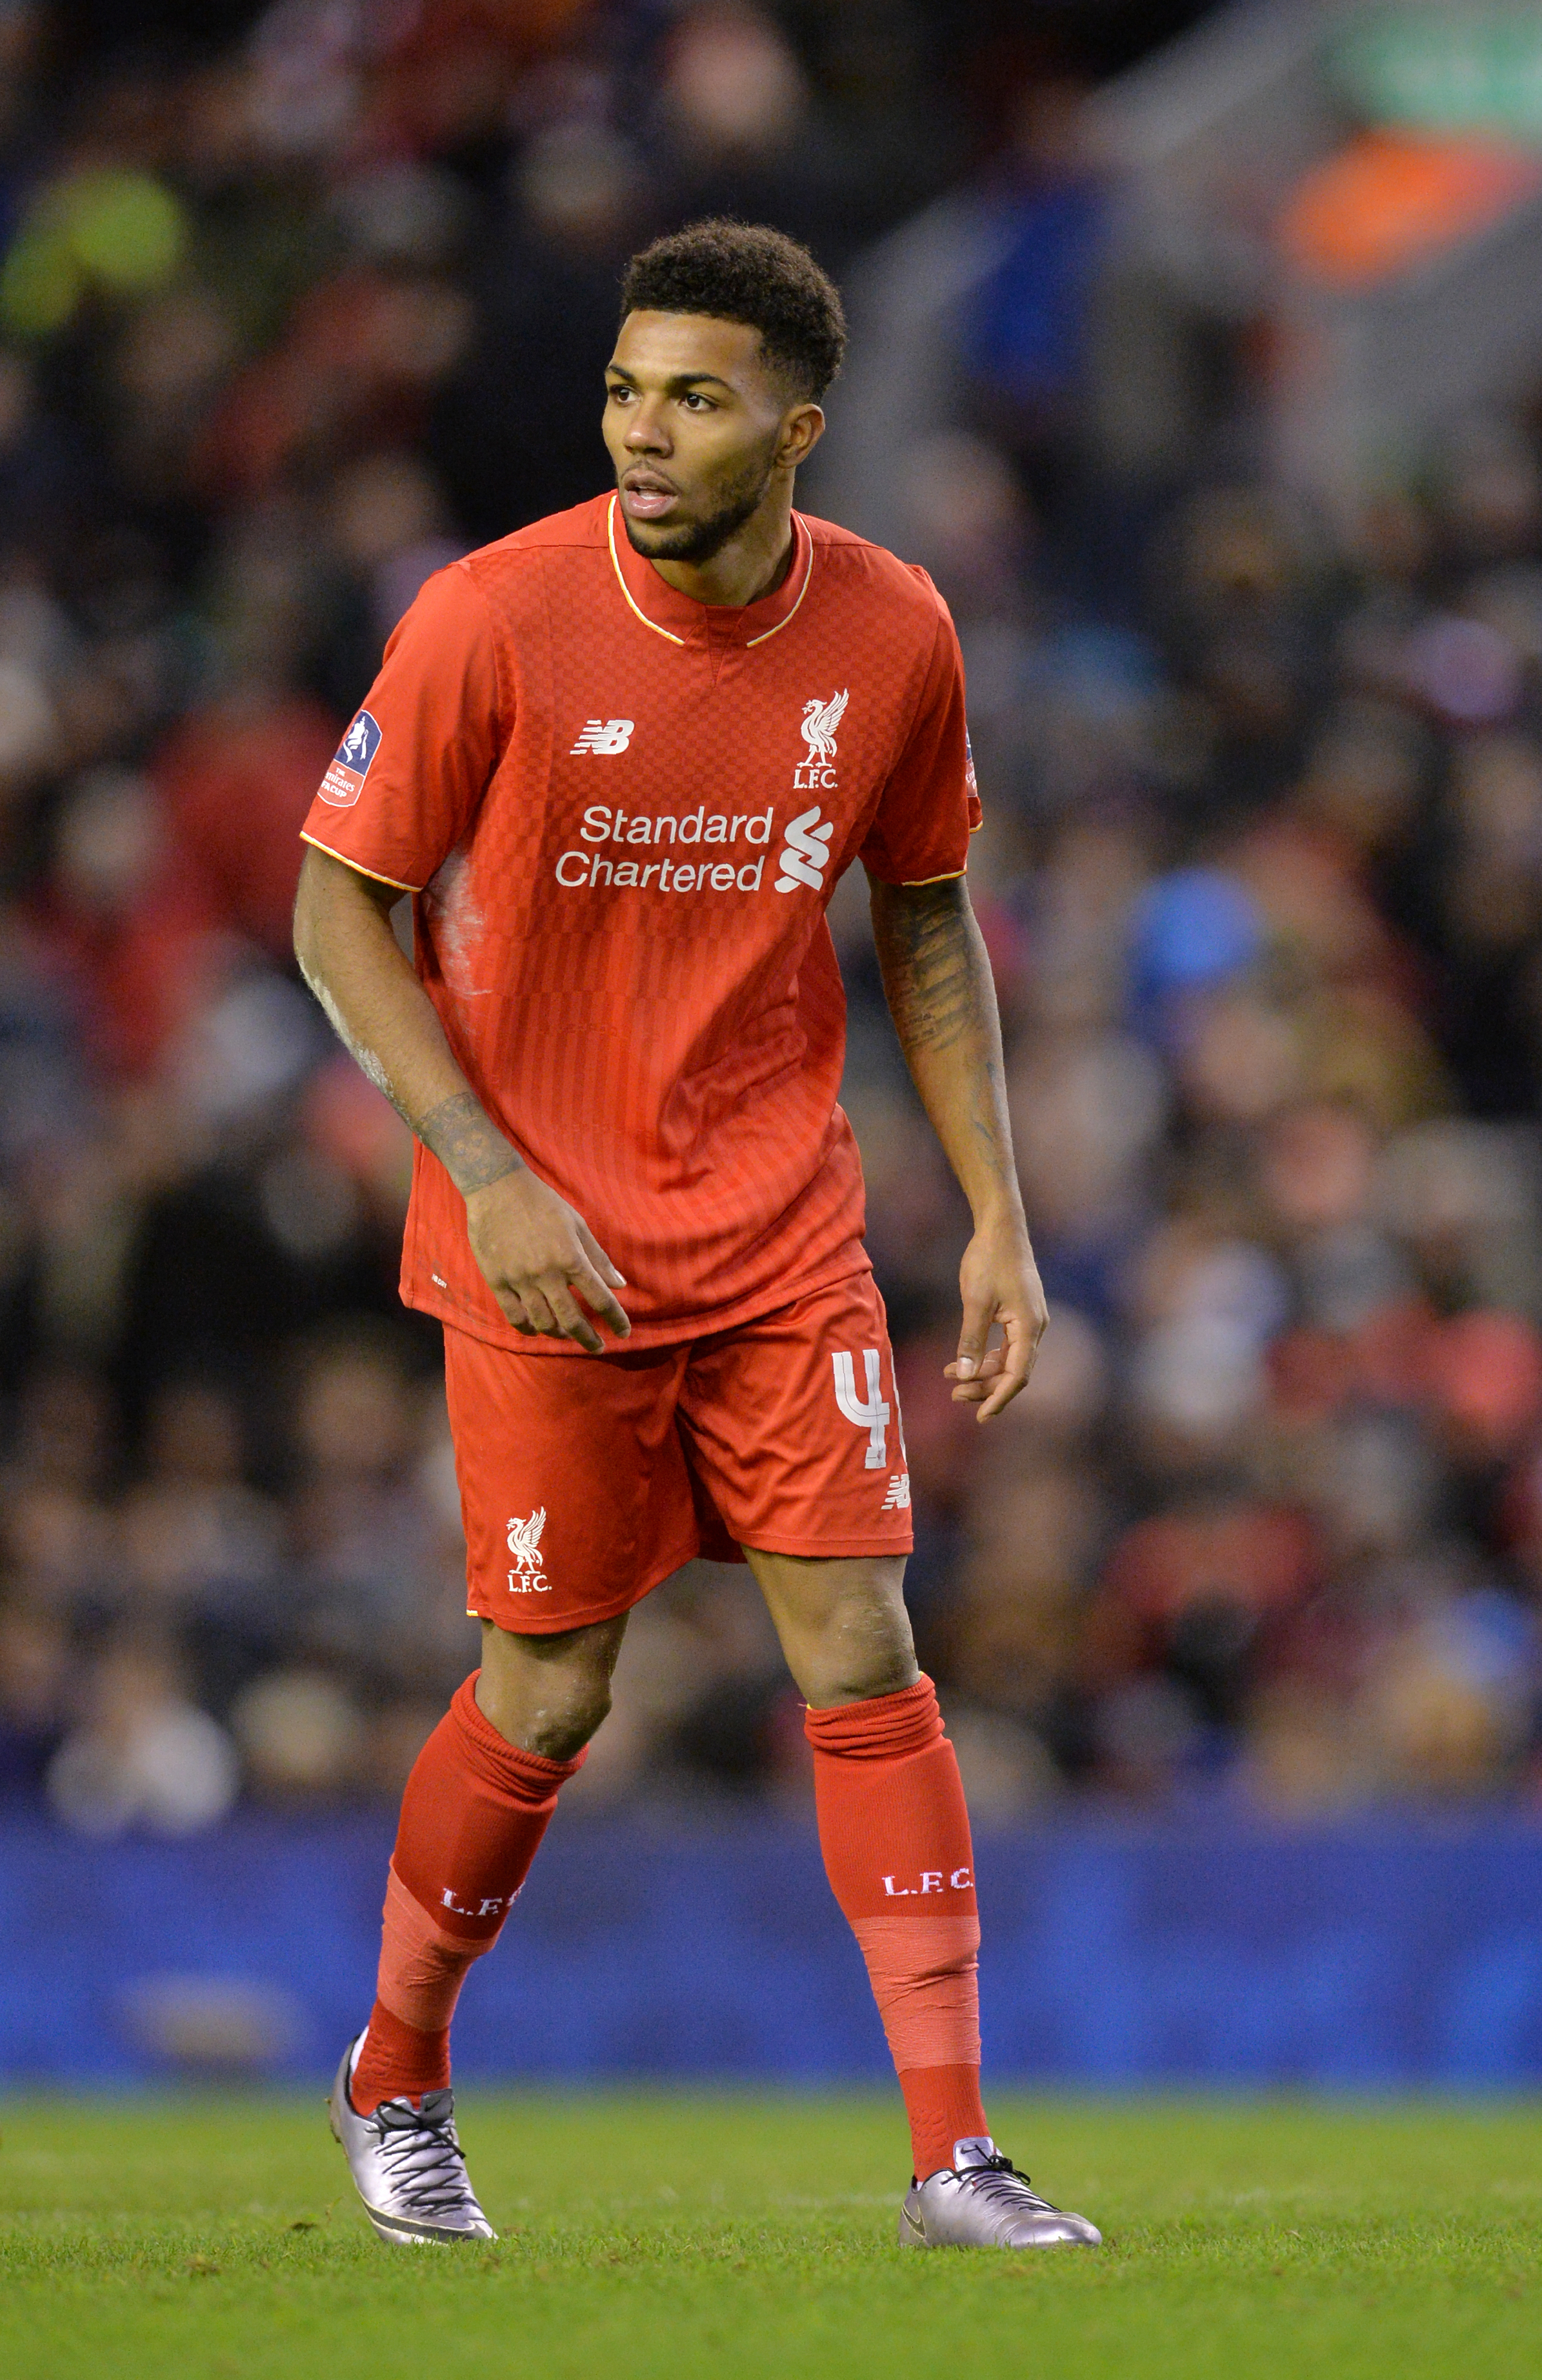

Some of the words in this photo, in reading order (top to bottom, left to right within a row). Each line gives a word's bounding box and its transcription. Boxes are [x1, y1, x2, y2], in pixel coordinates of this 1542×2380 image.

[570, 719, 635, 755] NB
[325, 772, 355, 792] mirates
[793, 769, 839, 789] L.F.C.
[580, 805, 774, 845] Standard
[555, 851, 766, 893] Chartered
[507, 1574, 552, 1593] L.F.C.
